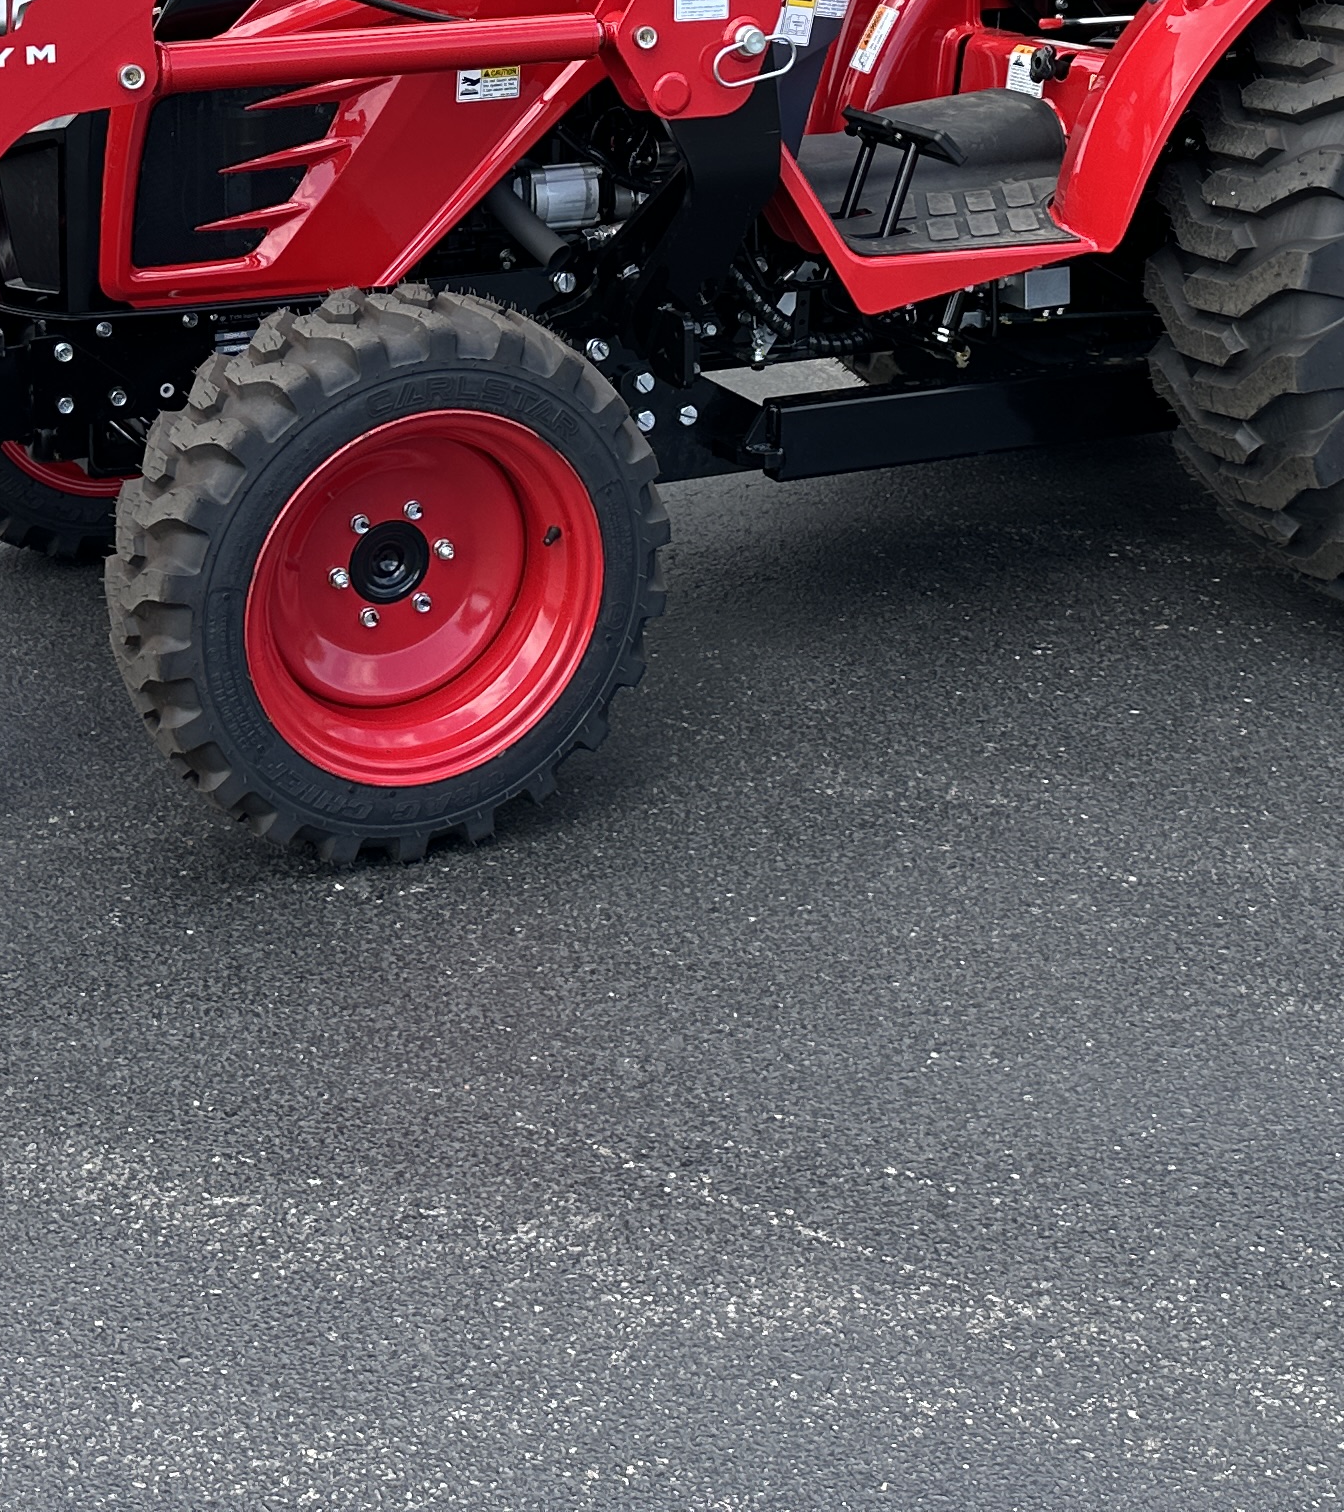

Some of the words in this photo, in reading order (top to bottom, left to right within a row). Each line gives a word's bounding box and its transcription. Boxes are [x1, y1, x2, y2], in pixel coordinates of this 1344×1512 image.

[367, 375, 580, 441] CARLSTAR
[255, 759, 375, 820] CHIEF
[392, 771, 509, 821] TRAC
